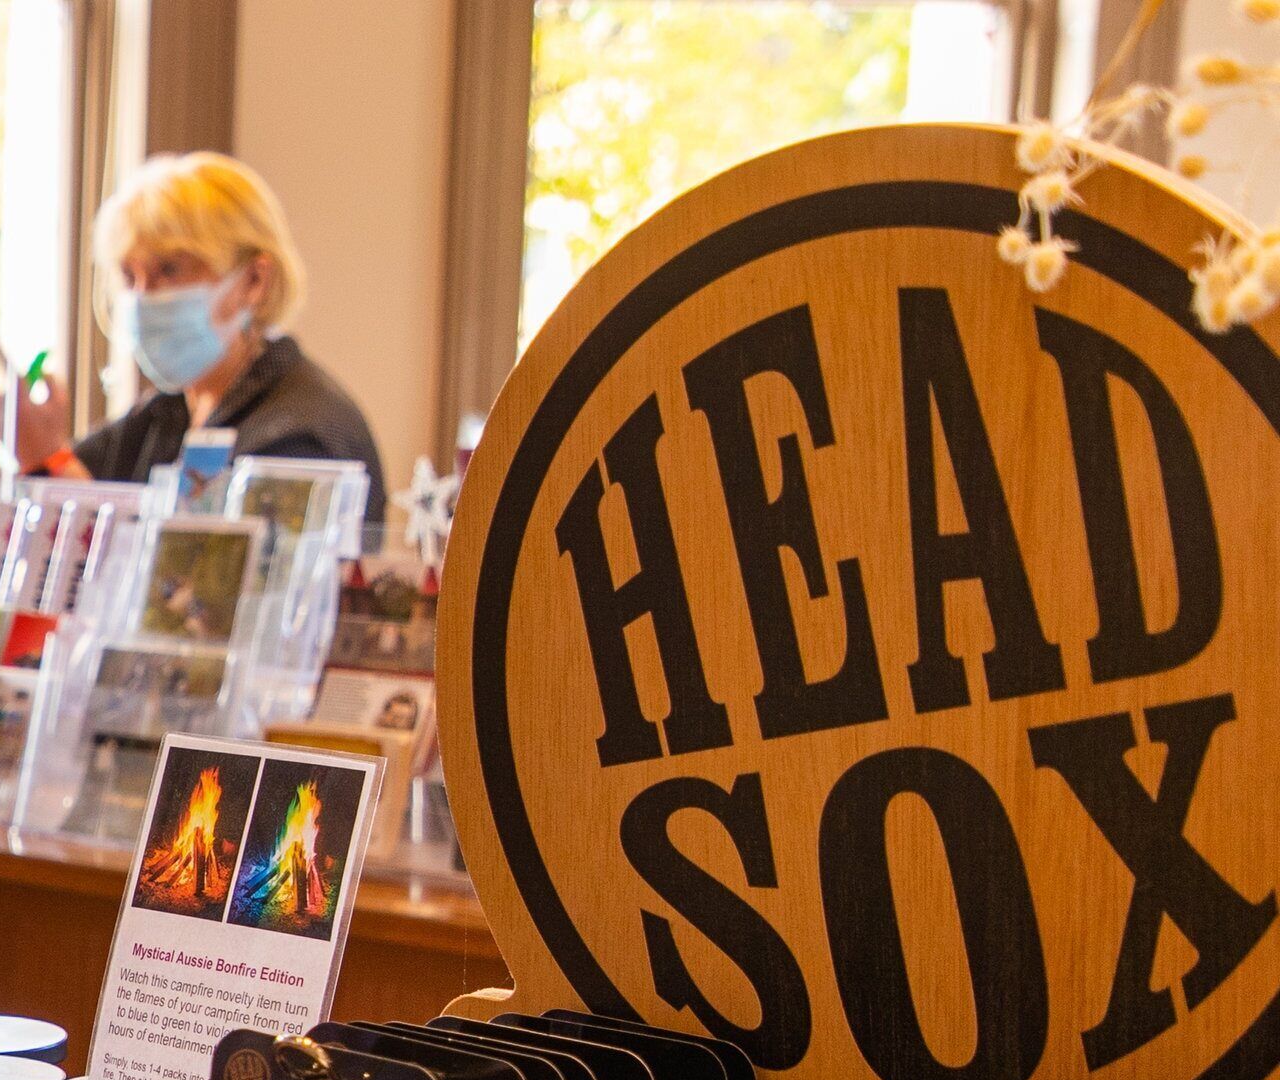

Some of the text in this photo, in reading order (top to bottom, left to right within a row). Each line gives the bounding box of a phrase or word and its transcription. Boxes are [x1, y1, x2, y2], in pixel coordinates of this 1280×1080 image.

[555, 286, 1227, 767] HEAD
[132, 943, 305, 987] Mystical Aussie Bonfire Edition
[116, 985, 304, 1035] the flames of your campfire from red
[120, 967, 309, 1016] Watch this campfire novelty item turn
[108, 1021, 148, 1041] hours of
[116, 1005, 203, 1034] to blue to green to
[130, 1060, 147, 1073] toss
[149, 1063, 162, 1075] 1-4
